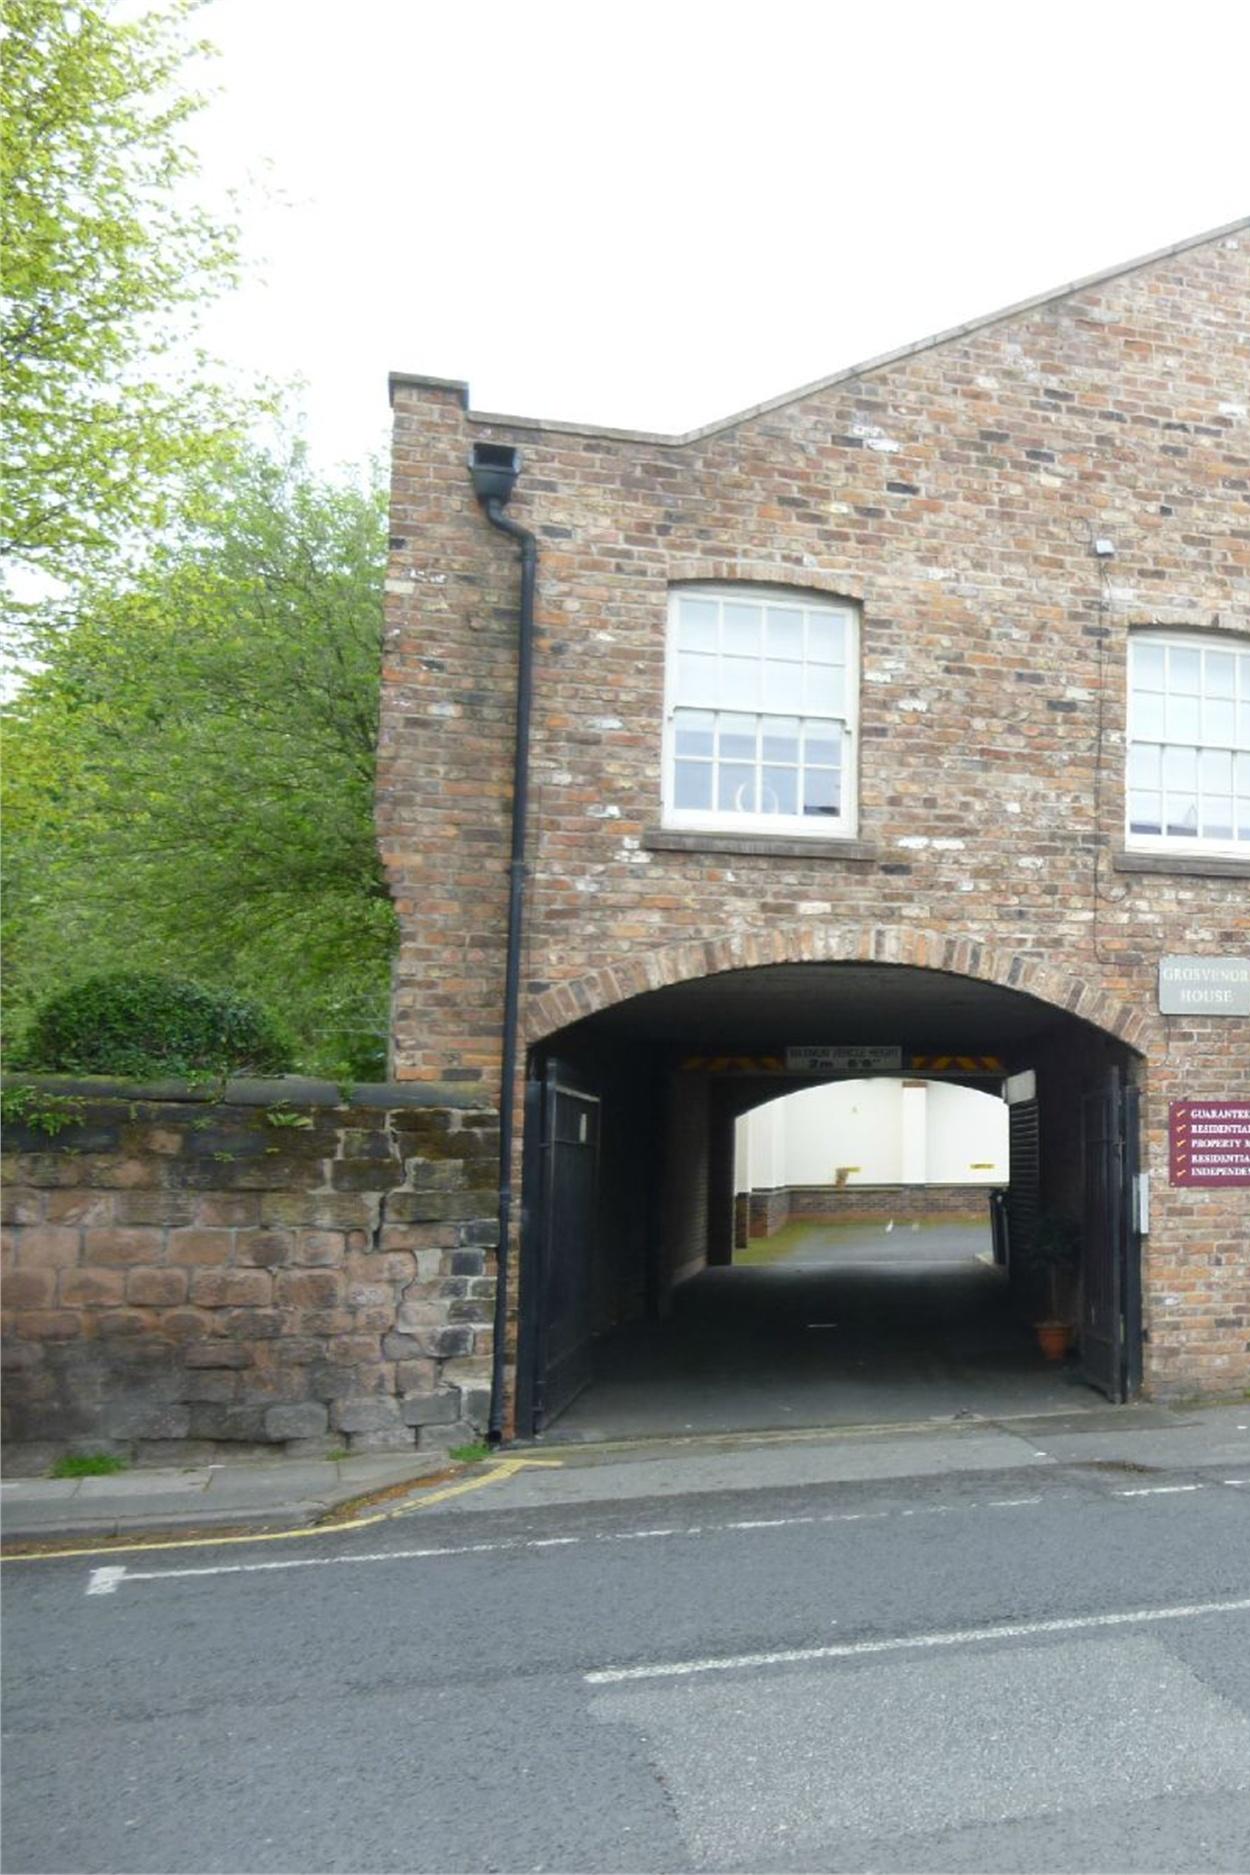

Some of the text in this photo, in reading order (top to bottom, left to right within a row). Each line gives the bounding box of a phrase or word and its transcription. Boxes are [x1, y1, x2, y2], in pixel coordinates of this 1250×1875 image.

[1163, 967, 1249, 983] GROSVENOR
[1180, 989, 1233, 1003] HOUSE
[1191, 1139, 1242, 1148] PROPERTY
